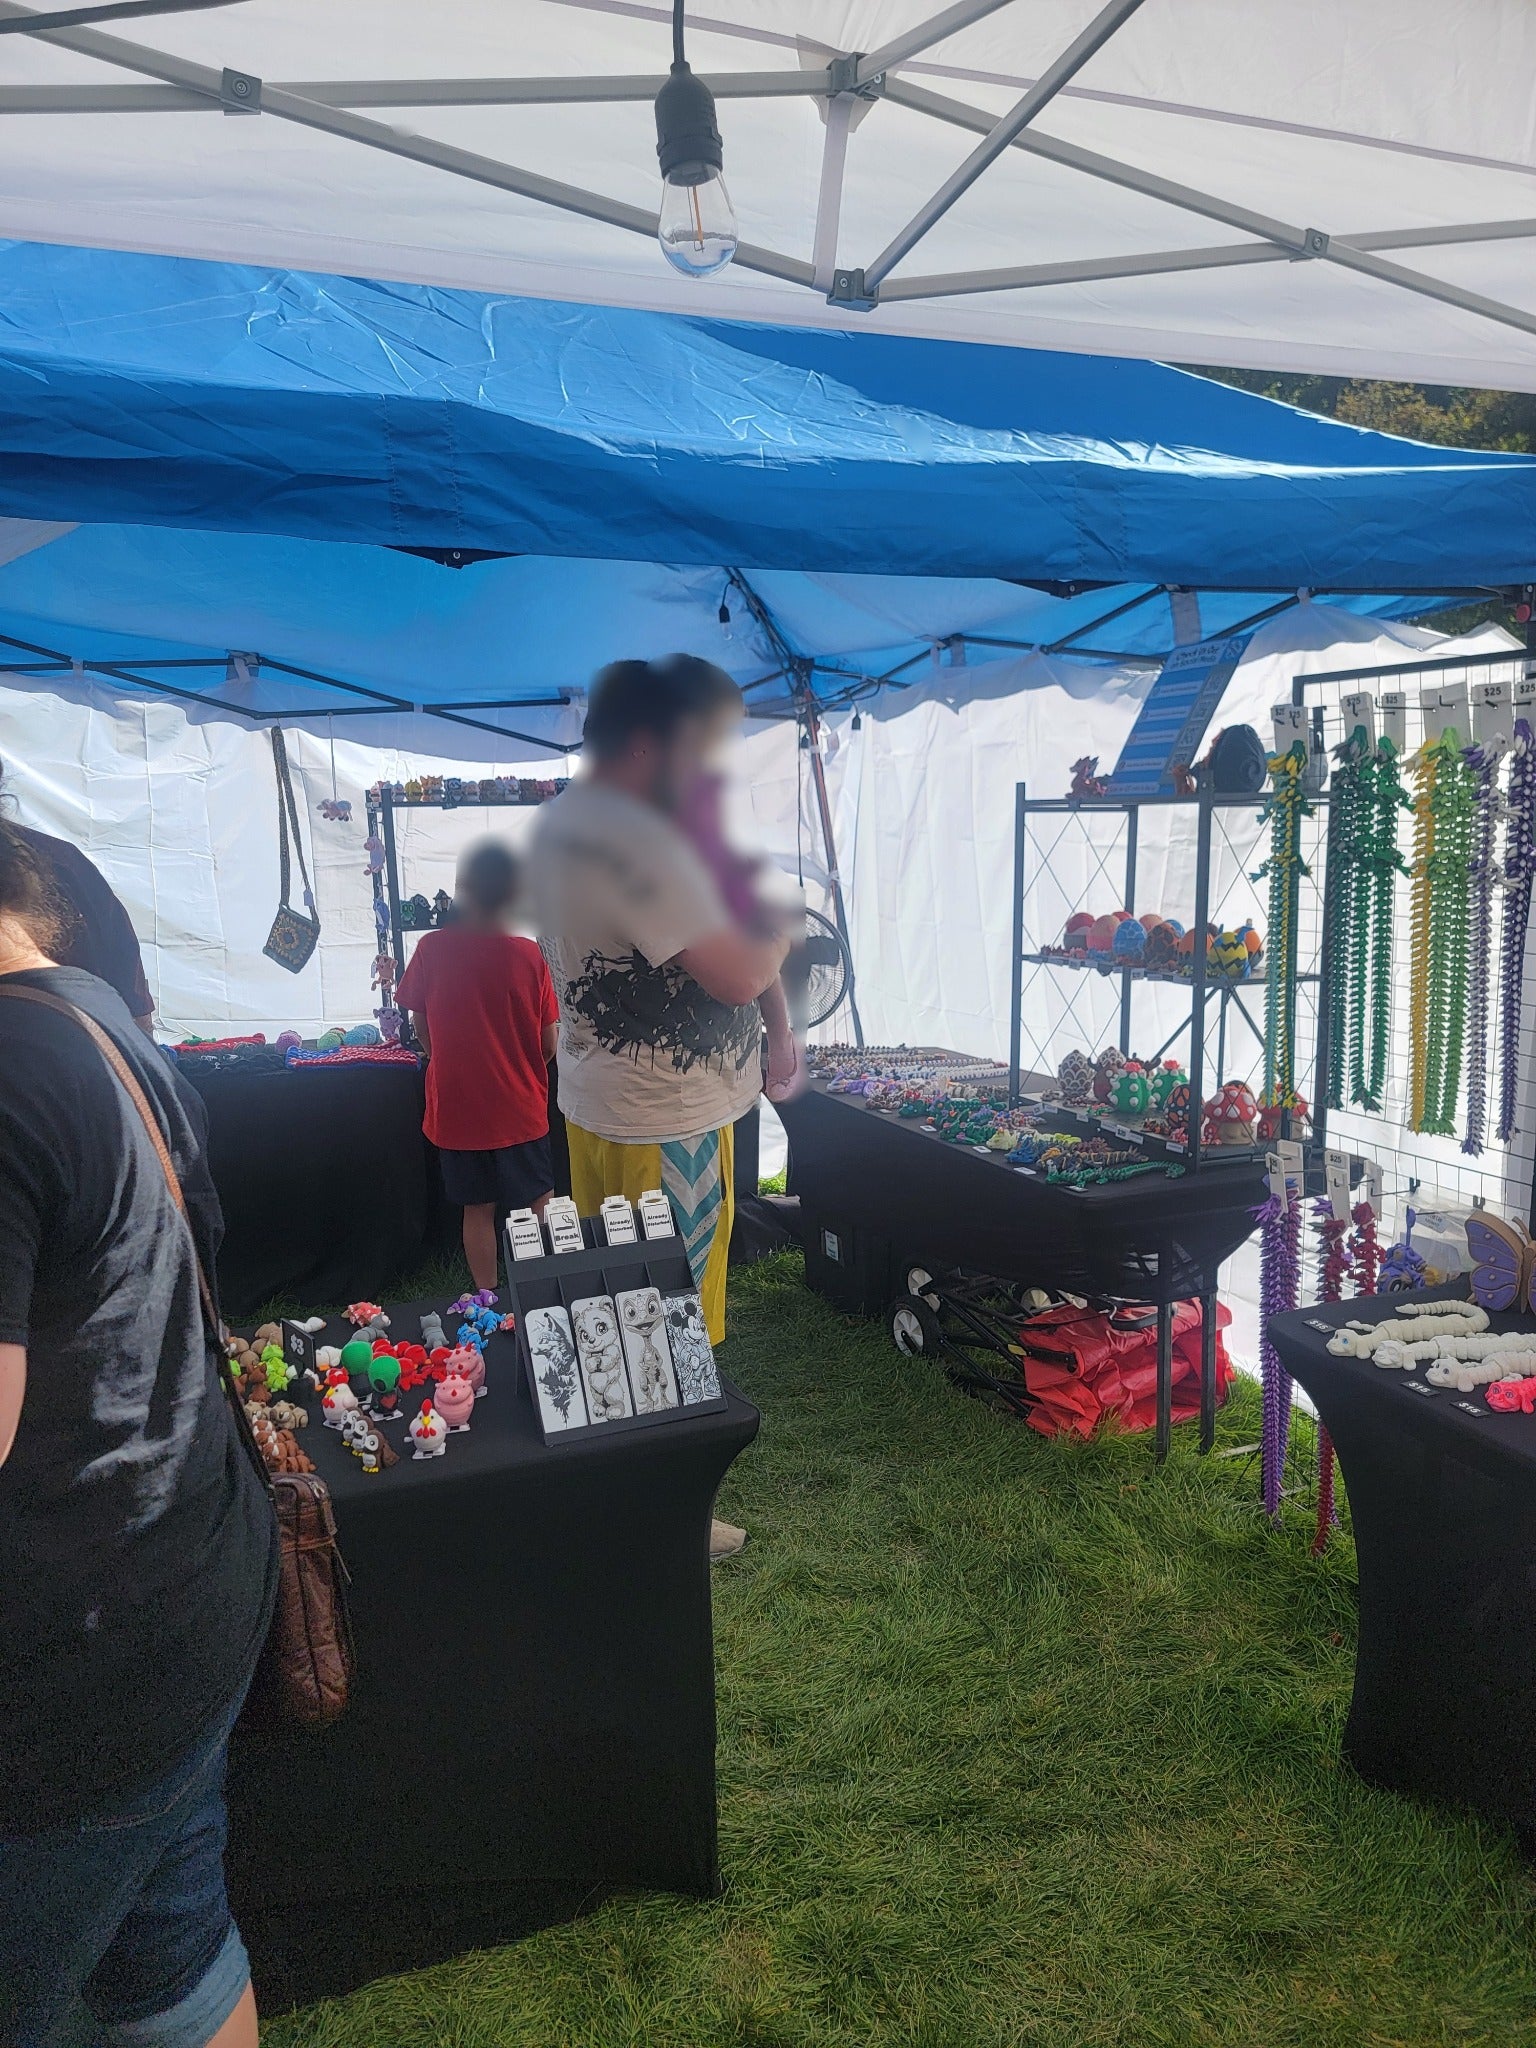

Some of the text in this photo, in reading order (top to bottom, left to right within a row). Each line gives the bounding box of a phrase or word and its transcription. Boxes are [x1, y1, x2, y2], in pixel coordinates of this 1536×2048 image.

[1484, 686, 1501, 697] $25
[1520, 683, 1536, 694] $25
[1386, 695, 1398, 704] $25
[1330, 1154, 1342, 1164] $25
[647, 1213, 668, 1221] Already
[609, 1225, 634, 1233] Disturbed
[514, 1231, 537, 1240] Already
[554, 1232, 580, 1242] Break
[514, 1239, 540, 1247] Disturbed
[1309, 1320, 1329, 1330] $15
[291, 1333, 304, 1355] $3
[1408, 1382, 1431, 1393] $15
[1458, 1402, 1481, 1413] $15
